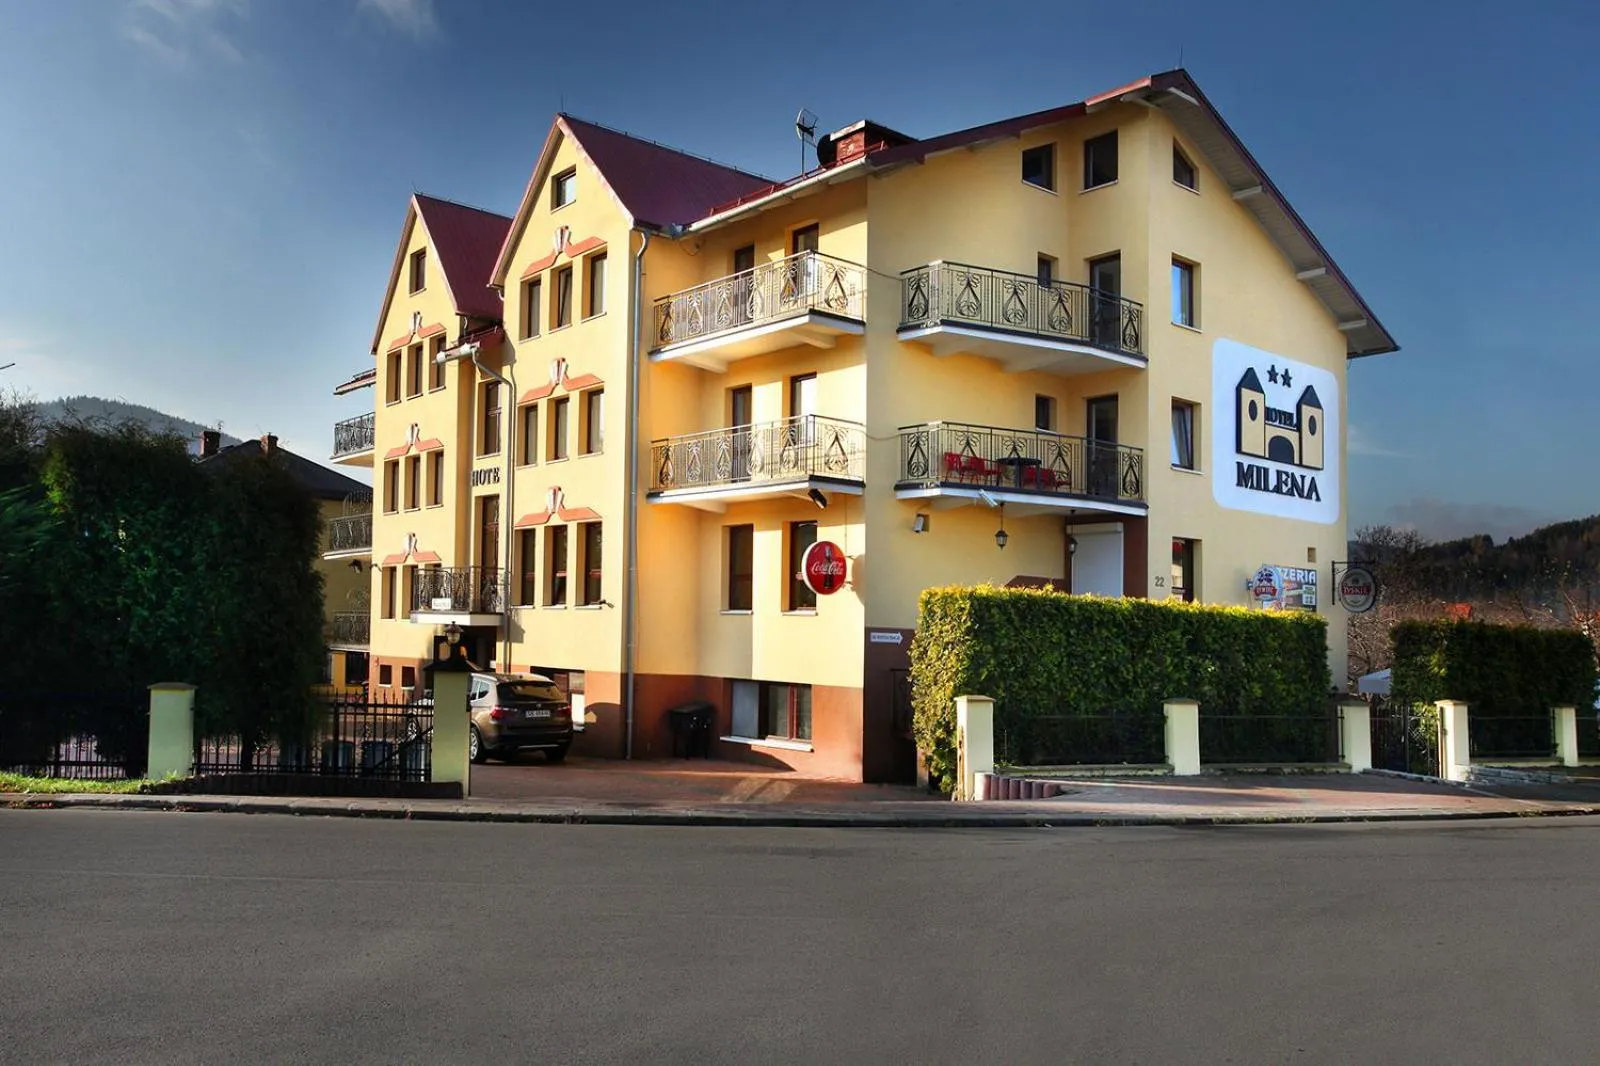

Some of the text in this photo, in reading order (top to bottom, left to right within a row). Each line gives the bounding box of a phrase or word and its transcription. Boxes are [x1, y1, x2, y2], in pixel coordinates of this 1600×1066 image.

[1236, 461, 1321, 501] MILENA
[1155, 576, 1165, 587] 22
[1278, 567, 1316, 584] ZERIA
